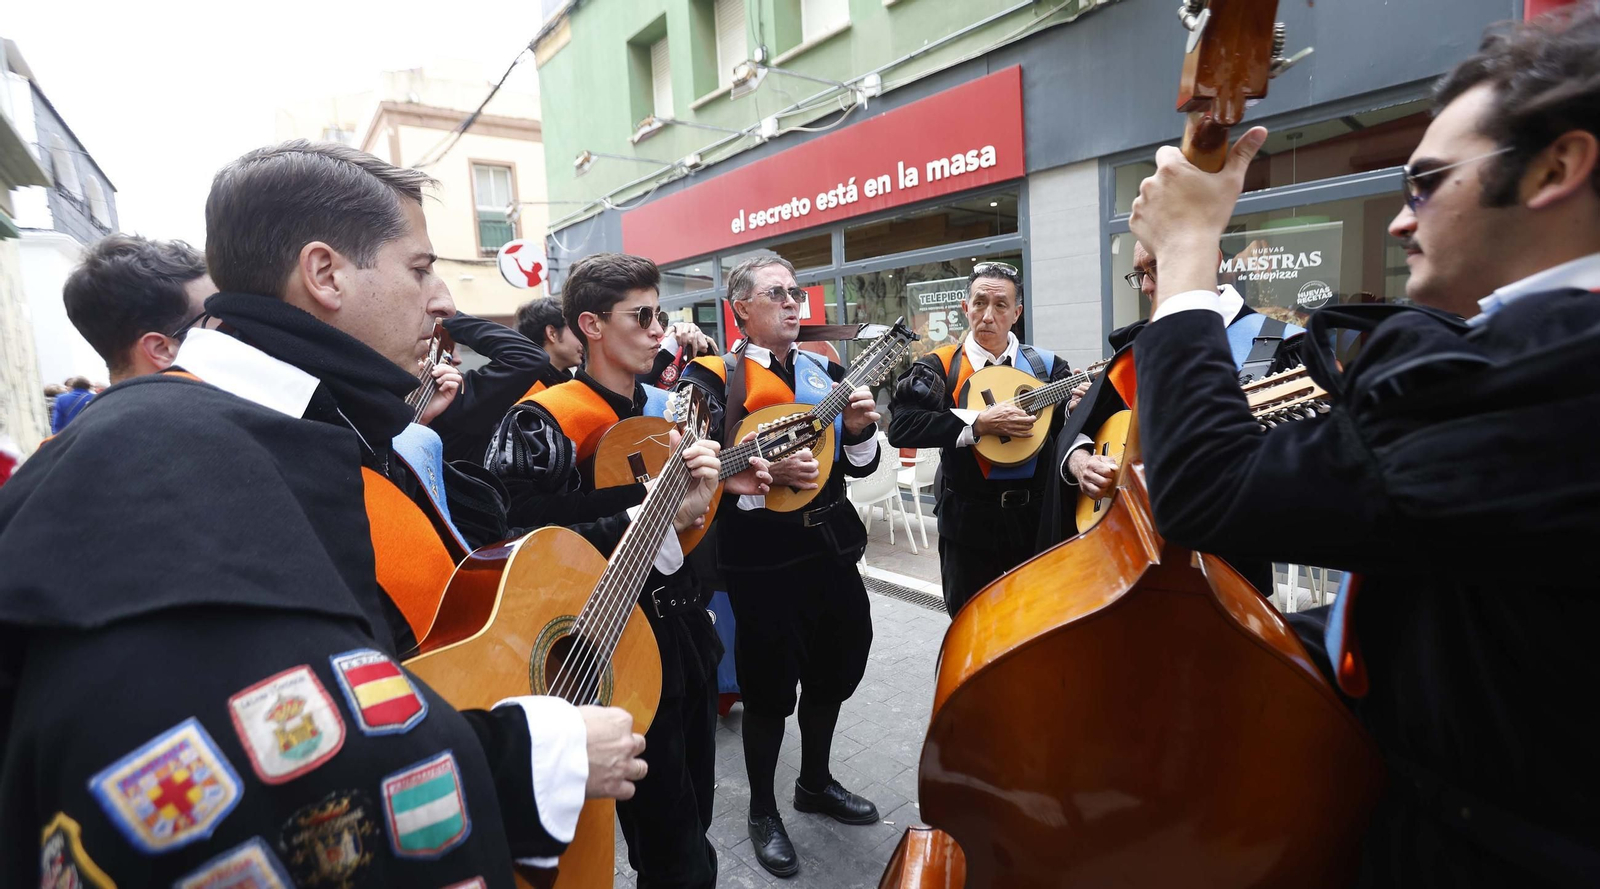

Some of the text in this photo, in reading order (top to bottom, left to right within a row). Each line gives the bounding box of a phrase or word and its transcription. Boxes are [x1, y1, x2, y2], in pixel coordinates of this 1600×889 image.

[731, 145, 996, 234] el secreto está en la masa
[1252, 246, 1284, 254] NUEVAS
[1219, 251, 1321, 273] MAESTRAS
[1249, 270, 1298, 282] telepizza
[1297, 286, 1331, 298] NUEVAS
[1297, 291, 1333, 304] RECETAS
